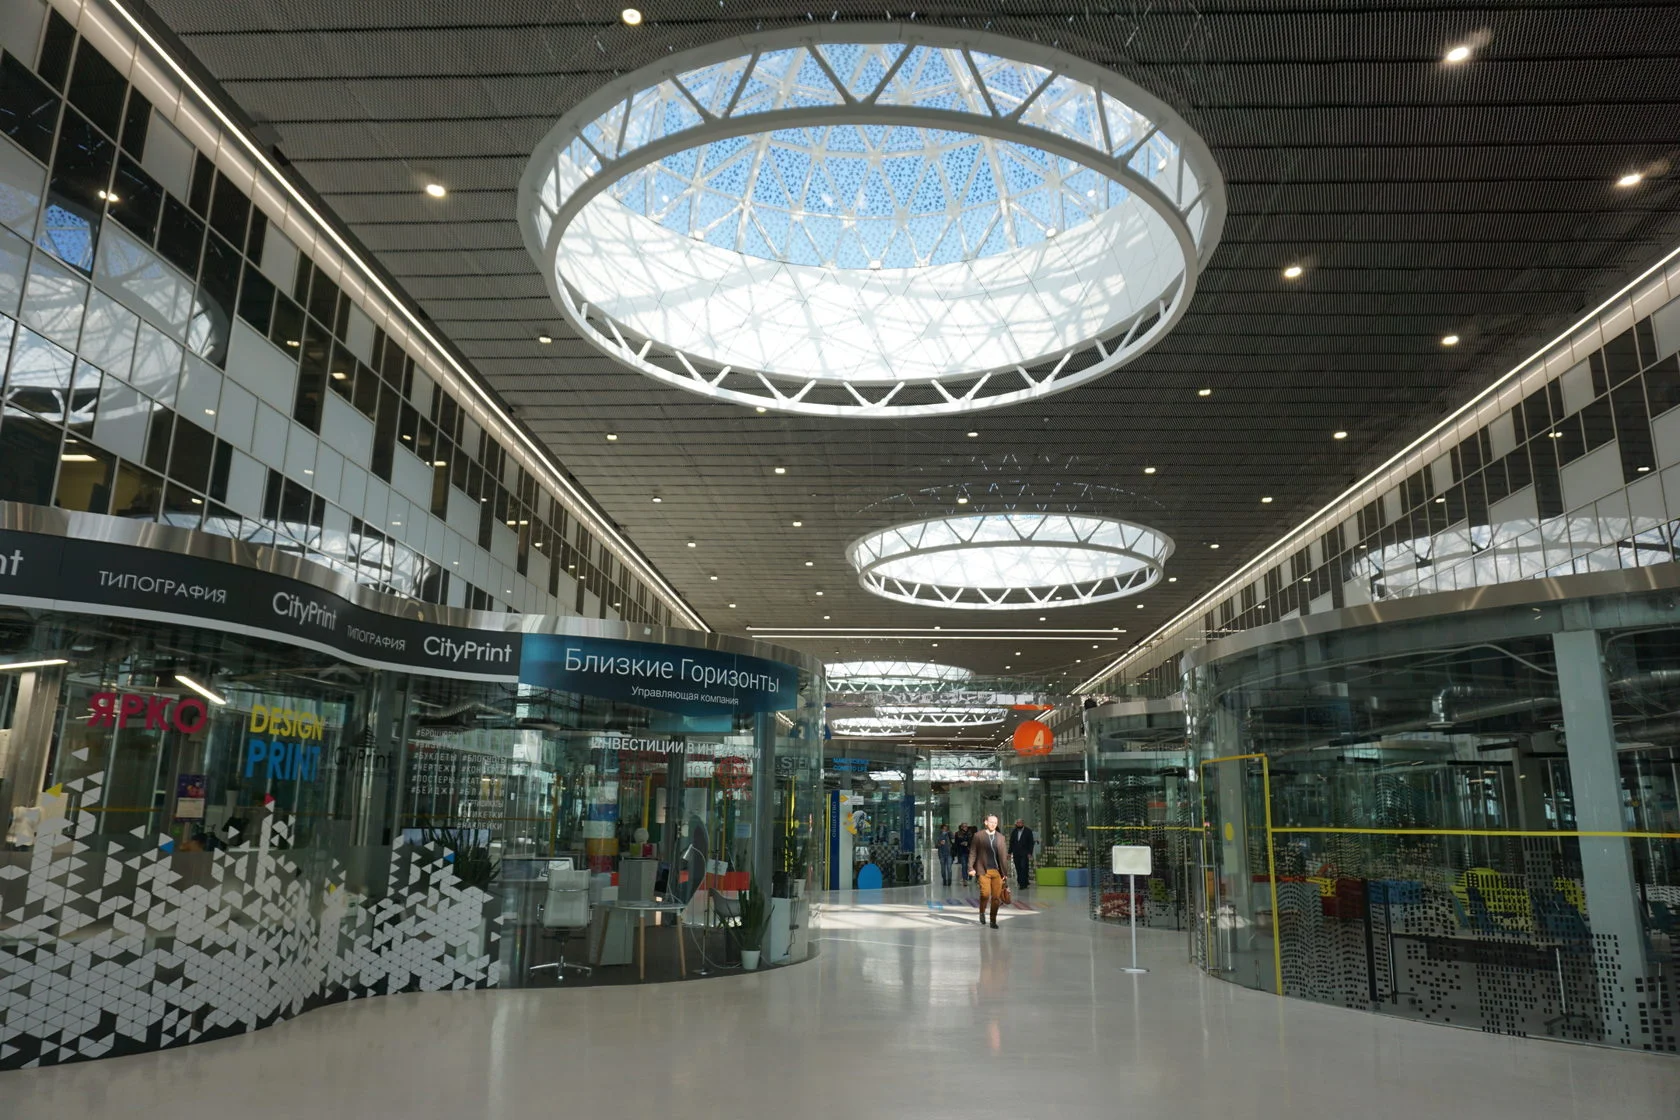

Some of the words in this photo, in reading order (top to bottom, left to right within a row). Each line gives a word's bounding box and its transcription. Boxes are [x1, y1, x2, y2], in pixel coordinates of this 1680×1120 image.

[98, 570, 228, 604] ТИПОГРАФИЯ
[272, 591, 337, 632] CityPrint
[347, 624, 407, 652] ТИПОГРАФИЯ
[423, 635, 512, 663] CityPrint
[564, 647, 674, 680] Близкие
[680, 658, 780, 694] Горизонты
[86, 692, 208, 734] ЯРКО
[631, 686, 699, 702] Управляющая
[700, 693, 740, 706] компания
[249, 704, 324, 741] DESIGN
[244, 739, 322, 782] PRINT
[591, 736, 684, 755] ИНВЕСТИЦИИ
[686, 741, 695, 754] В
